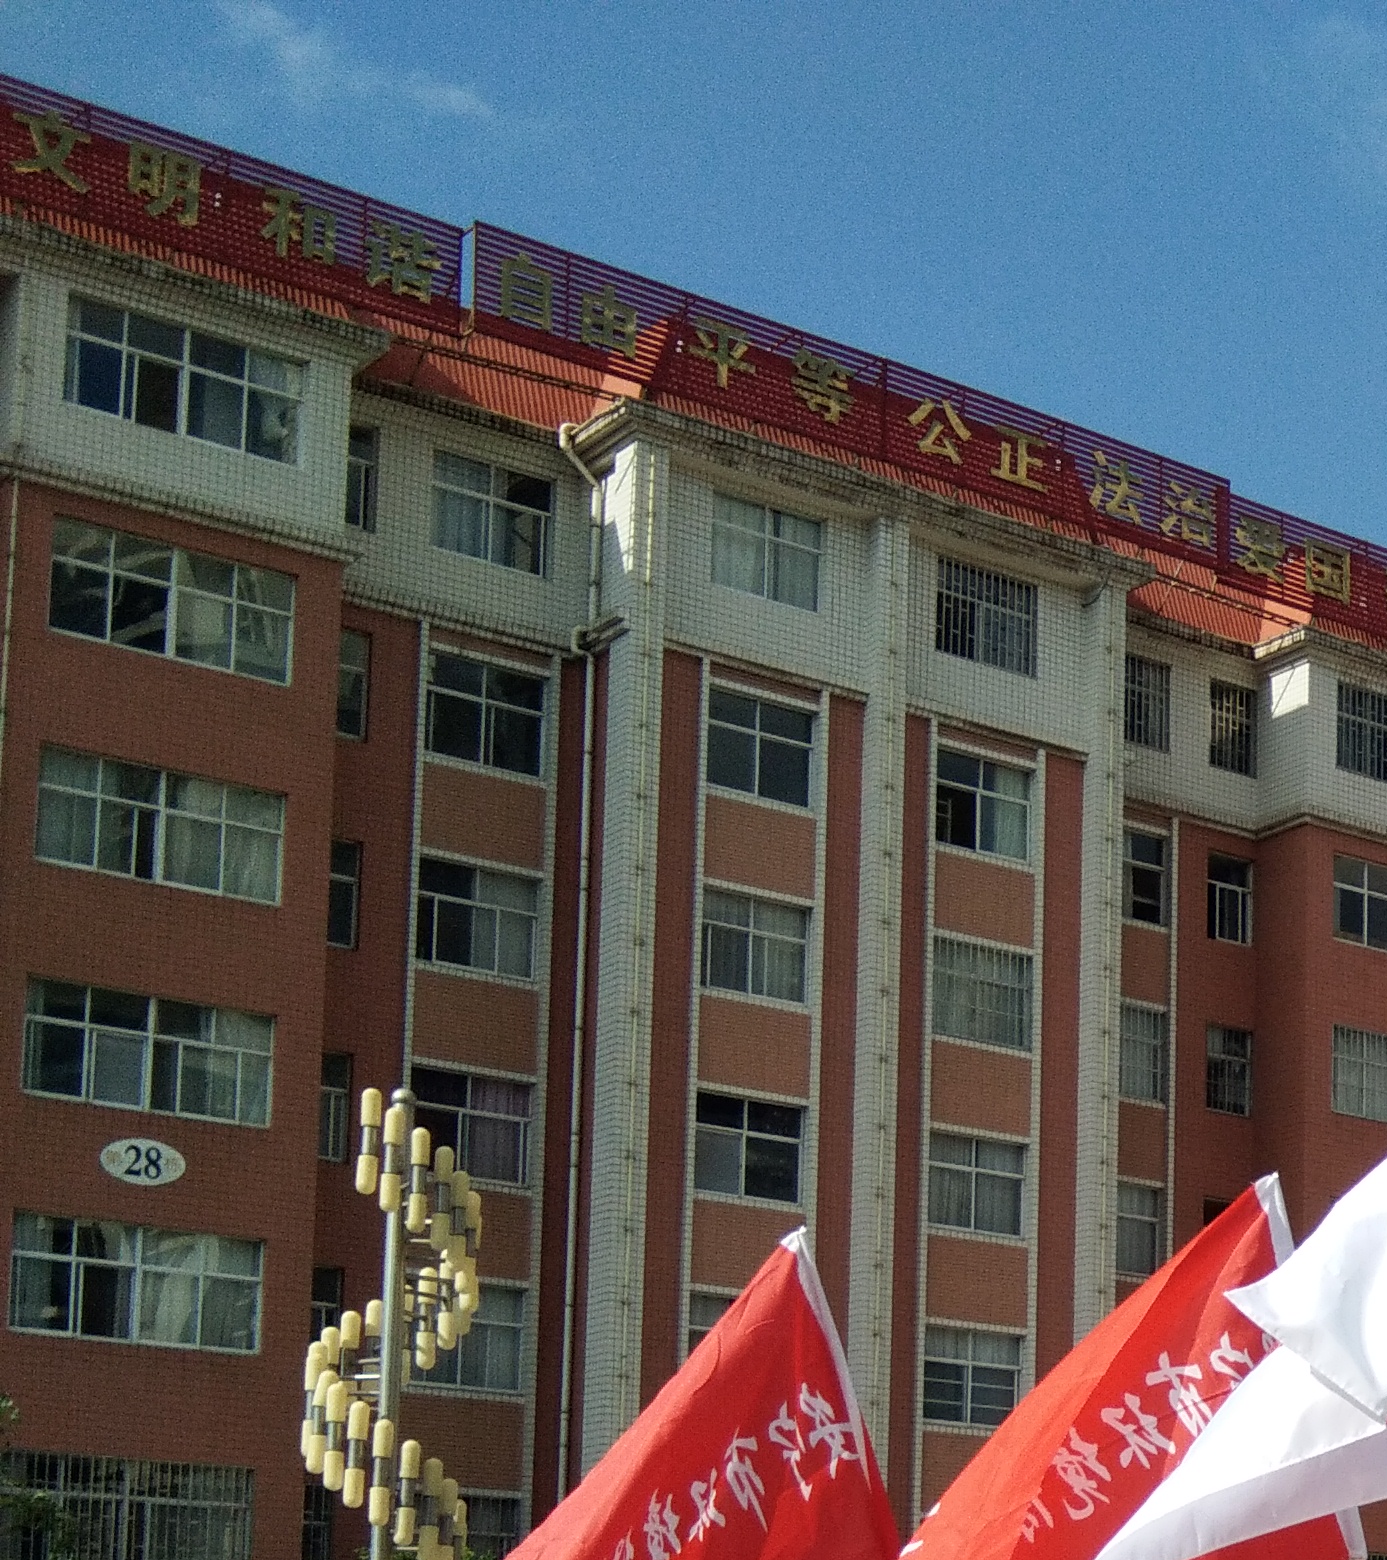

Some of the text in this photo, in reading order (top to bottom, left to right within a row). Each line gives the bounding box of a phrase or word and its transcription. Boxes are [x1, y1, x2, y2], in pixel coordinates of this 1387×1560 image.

[11, 109, 203, 228] 文明
[260, 184, 442, 305] 和谐
[499, 252, 640, 360] 自由
[686, 316, 859, 425] 平等
[906, 397, 1054, 494] 公正
[1088, 450, 1217, 548] 法治
[1234, 515, 1352, 607] 爱国
[124, 1145, 162, 1180] 28
